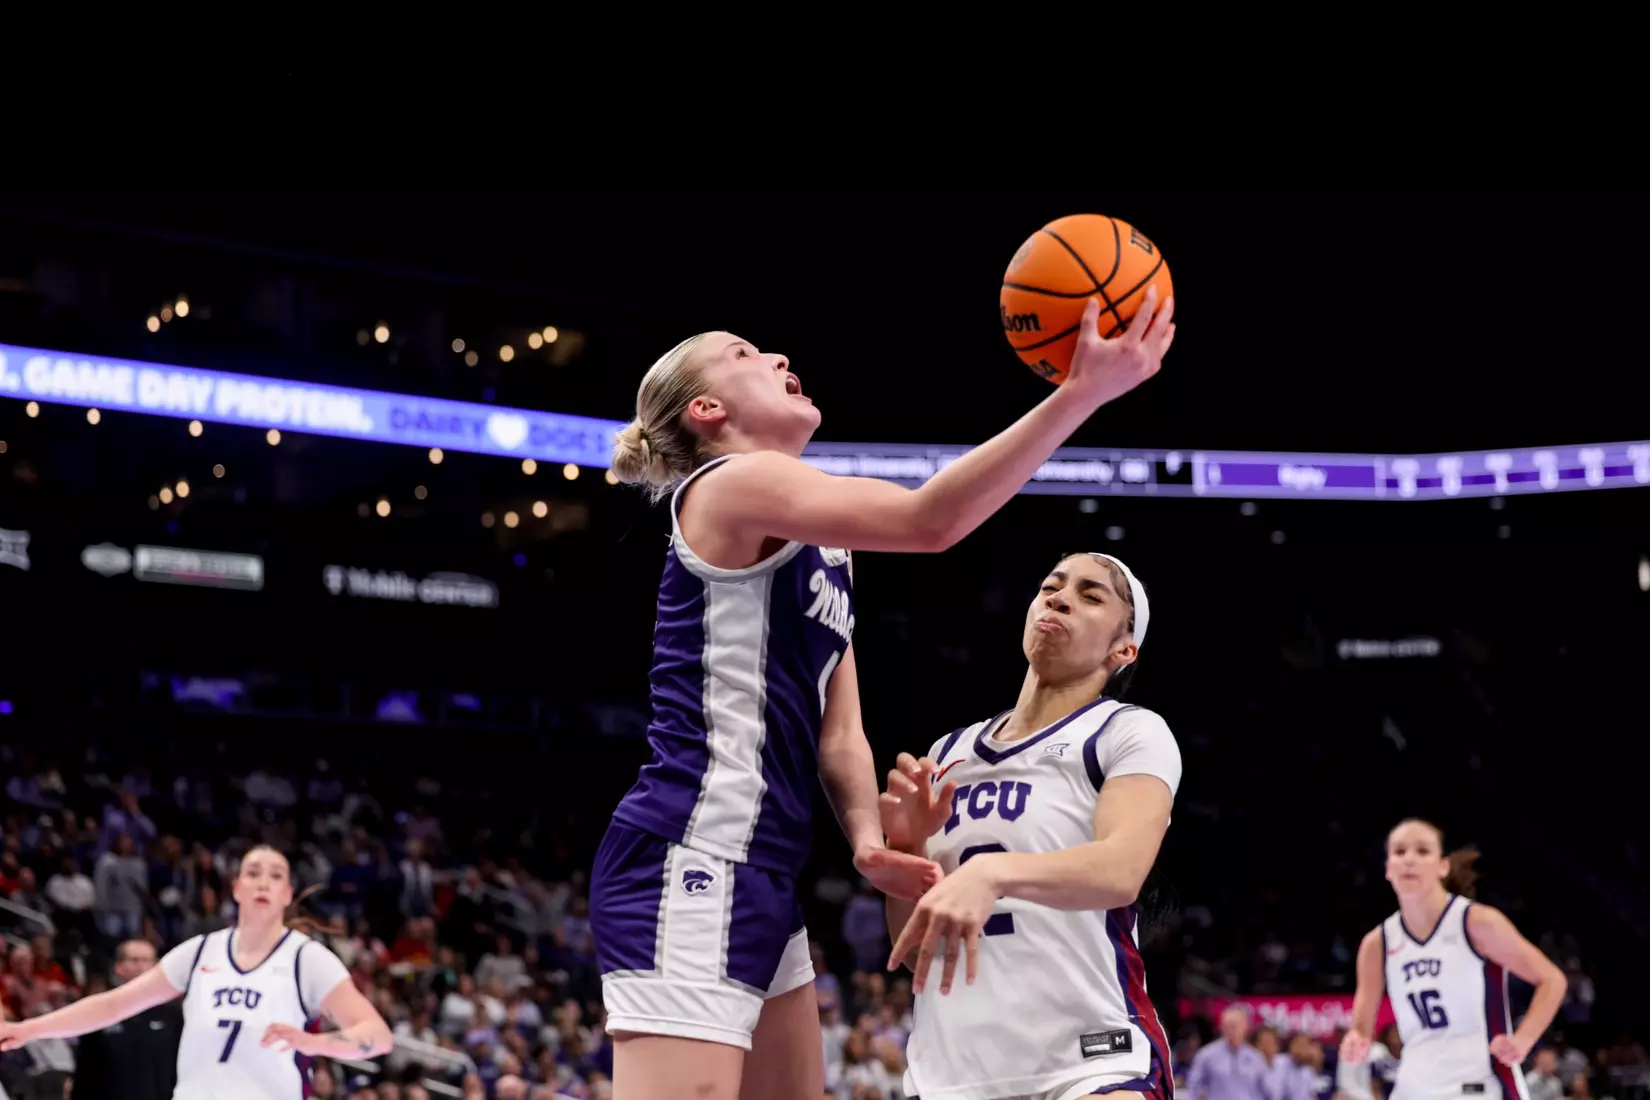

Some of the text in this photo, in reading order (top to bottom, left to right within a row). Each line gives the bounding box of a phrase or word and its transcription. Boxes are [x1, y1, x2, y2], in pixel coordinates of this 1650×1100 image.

[23, 355, 134, 405] GAME
[137, 368, 213, 412] DAY
[389, 407, 487, 439] DAIRY
[945, 780, 1032, 836] TCU
[1402, 958, 1441, 983] TCU
[212, 987, 262, 1010] TCU
[1408, 989, 1449, 1030] 16
[217, 1019, 243, 1064] 7
[1115, 1035, 1126, 1046] M
